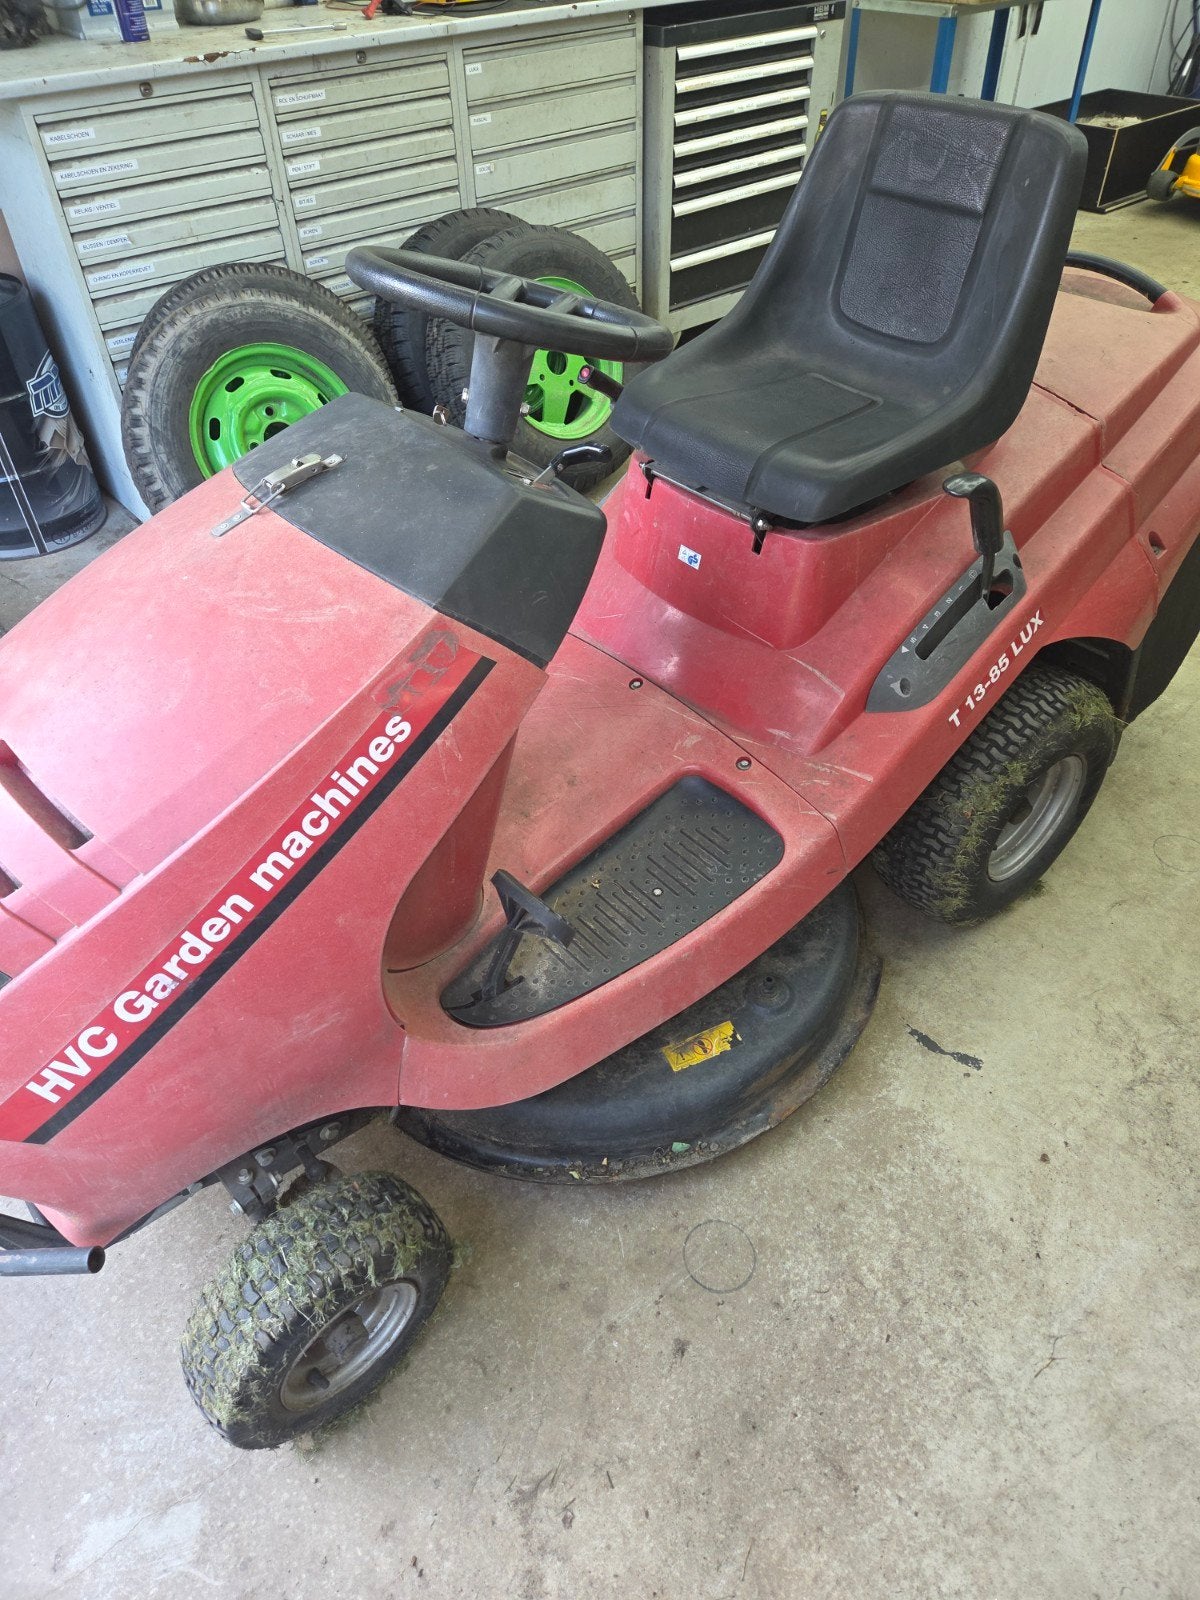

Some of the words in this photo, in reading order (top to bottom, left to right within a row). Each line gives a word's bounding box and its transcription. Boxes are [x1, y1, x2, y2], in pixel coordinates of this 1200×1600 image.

[49, 131, 90, 142] KABELSCHOEN
[60, 168, 99, 179] KABELSCHOEN
[99, 166, 107, 174] EN
[107, 162, 134, 172] ZEKERING
[948, 708, 961, 728] T
[965, 653, 1010, 710] 13-85
[1010, 609, 1045, 657] LUX
[25, 1026, 118, 1103] HVC
[113, 893, 255, 1023] Garden
[249, 715, 412, 892] machines
